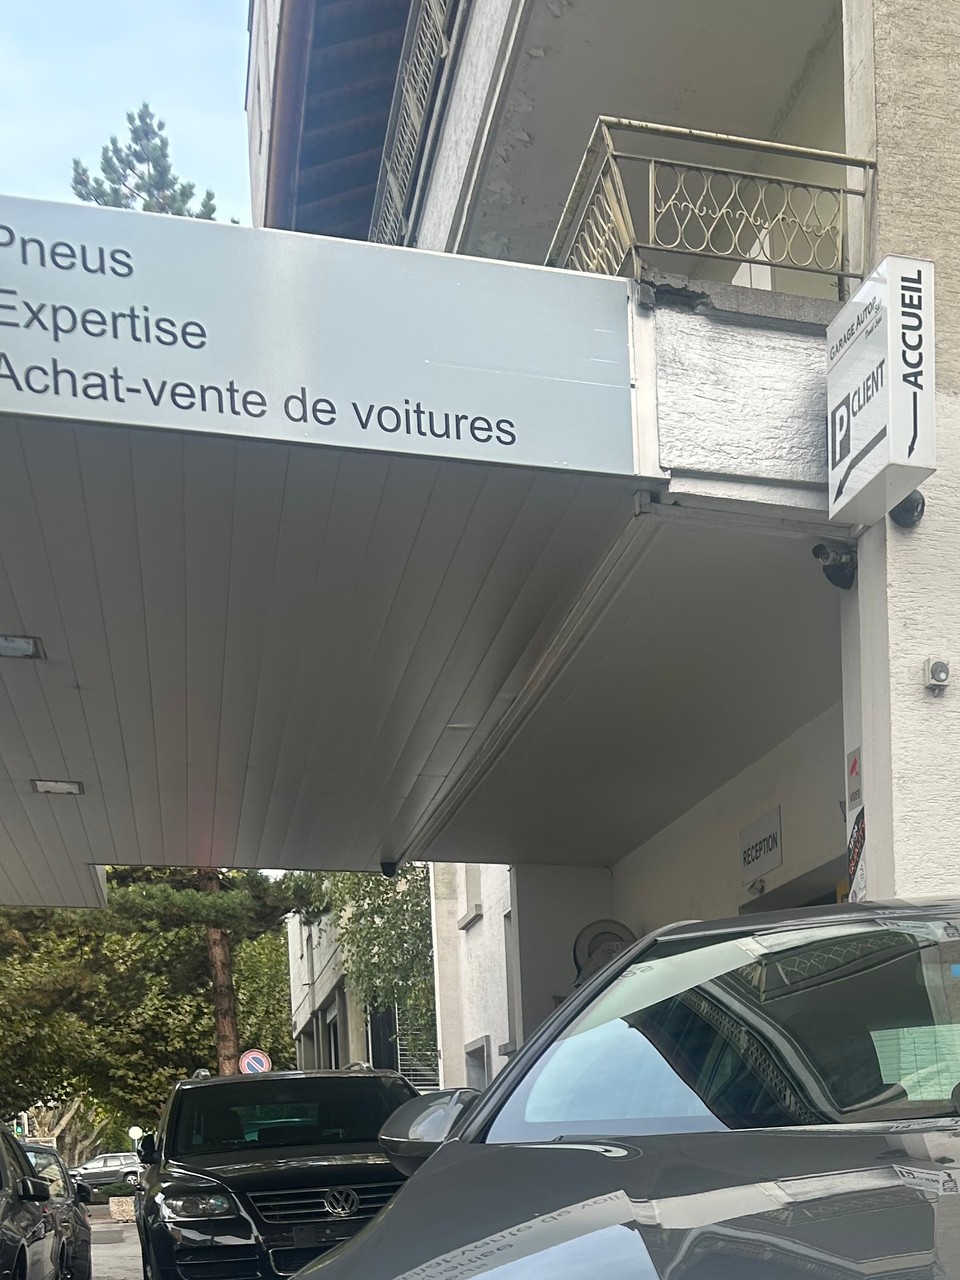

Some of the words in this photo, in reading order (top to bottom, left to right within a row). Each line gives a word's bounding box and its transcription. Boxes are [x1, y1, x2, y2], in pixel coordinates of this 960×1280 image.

[0, 223, 134, 278] Pneus
[0, 287, 208, 350] Expertise
[829, 322, 856, 361] GARAGE
[856, 295, 877, 332] AUTOP
[900, 269, 924, 392] ACCUEIL
[0, 351, 268, 419] Achat-vente
[284, 386, 337, 426] de
[351, 398, 517, 446] voitures
[851, 357, 886, 418] CLIENT
